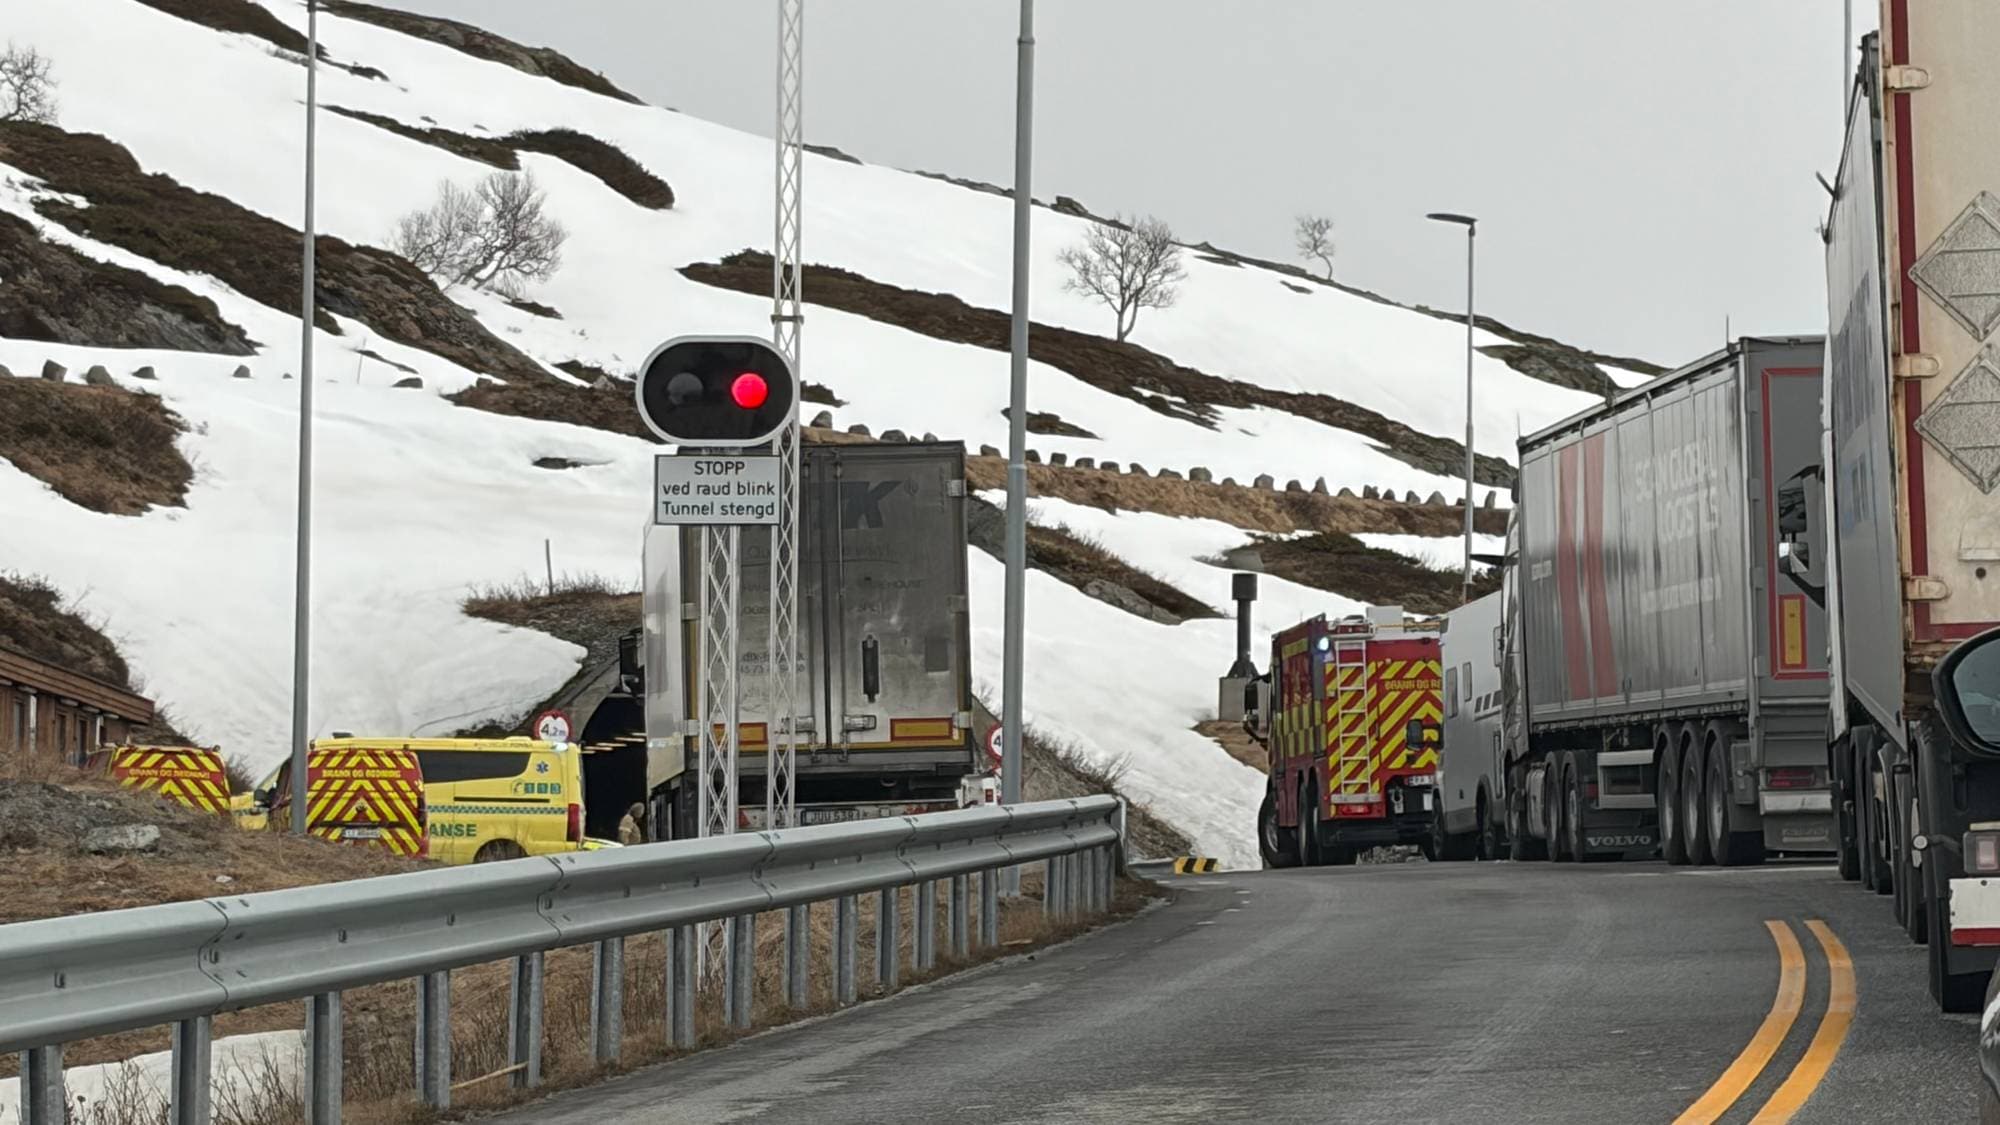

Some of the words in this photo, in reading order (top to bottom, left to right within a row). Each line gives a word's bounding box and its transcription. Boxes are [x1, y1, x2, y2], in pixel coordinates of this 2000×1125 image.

[694, 460, 745, 475] STOPP
[662, 481, 690, 495] ved
[696, 481, 730, 495] raud
[737, 481, 775, 495] blink
[662, 501, 714, 515] Tunnel
[720, 501, 775, 519] stengd
[1587, 835, 1651, 847] VOLVO
